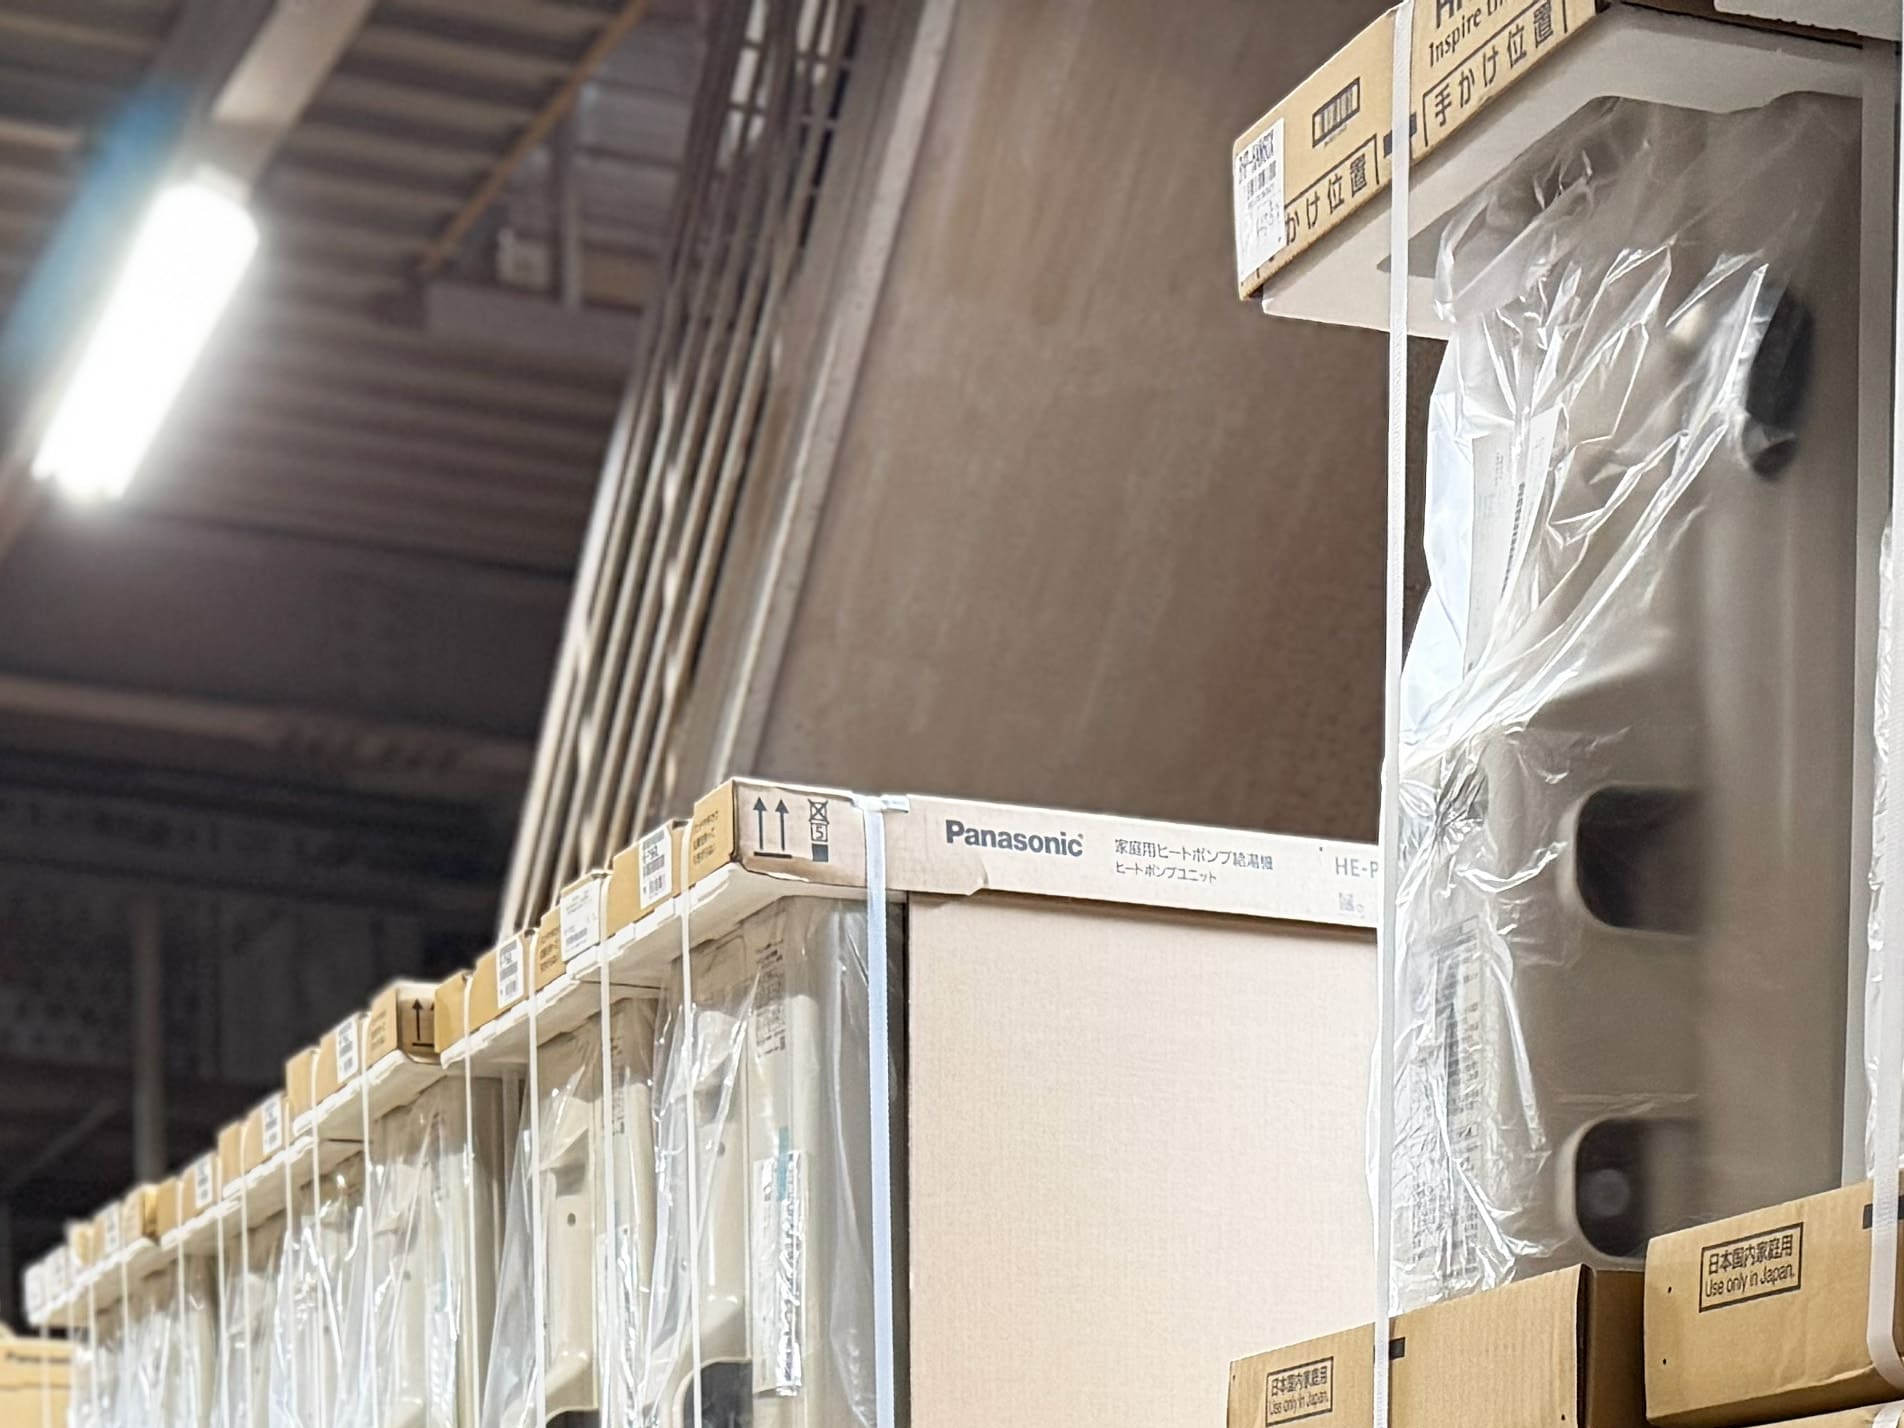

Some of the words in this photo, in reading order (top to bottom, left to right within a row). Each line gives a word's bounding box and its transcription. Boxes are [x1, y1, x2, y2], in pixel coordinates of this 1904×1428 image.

[1429, 7, 1482, 68] Inspire
[945, 819, 1083, 858] Panasonic
[1708, 1234, 1793, 1275] 日本国内家庭用
[1705, 1279, 1725, 1298] Use
[1726, 1273, 1747, 1295] only
[1749, 1270, 1759, 1287] in
